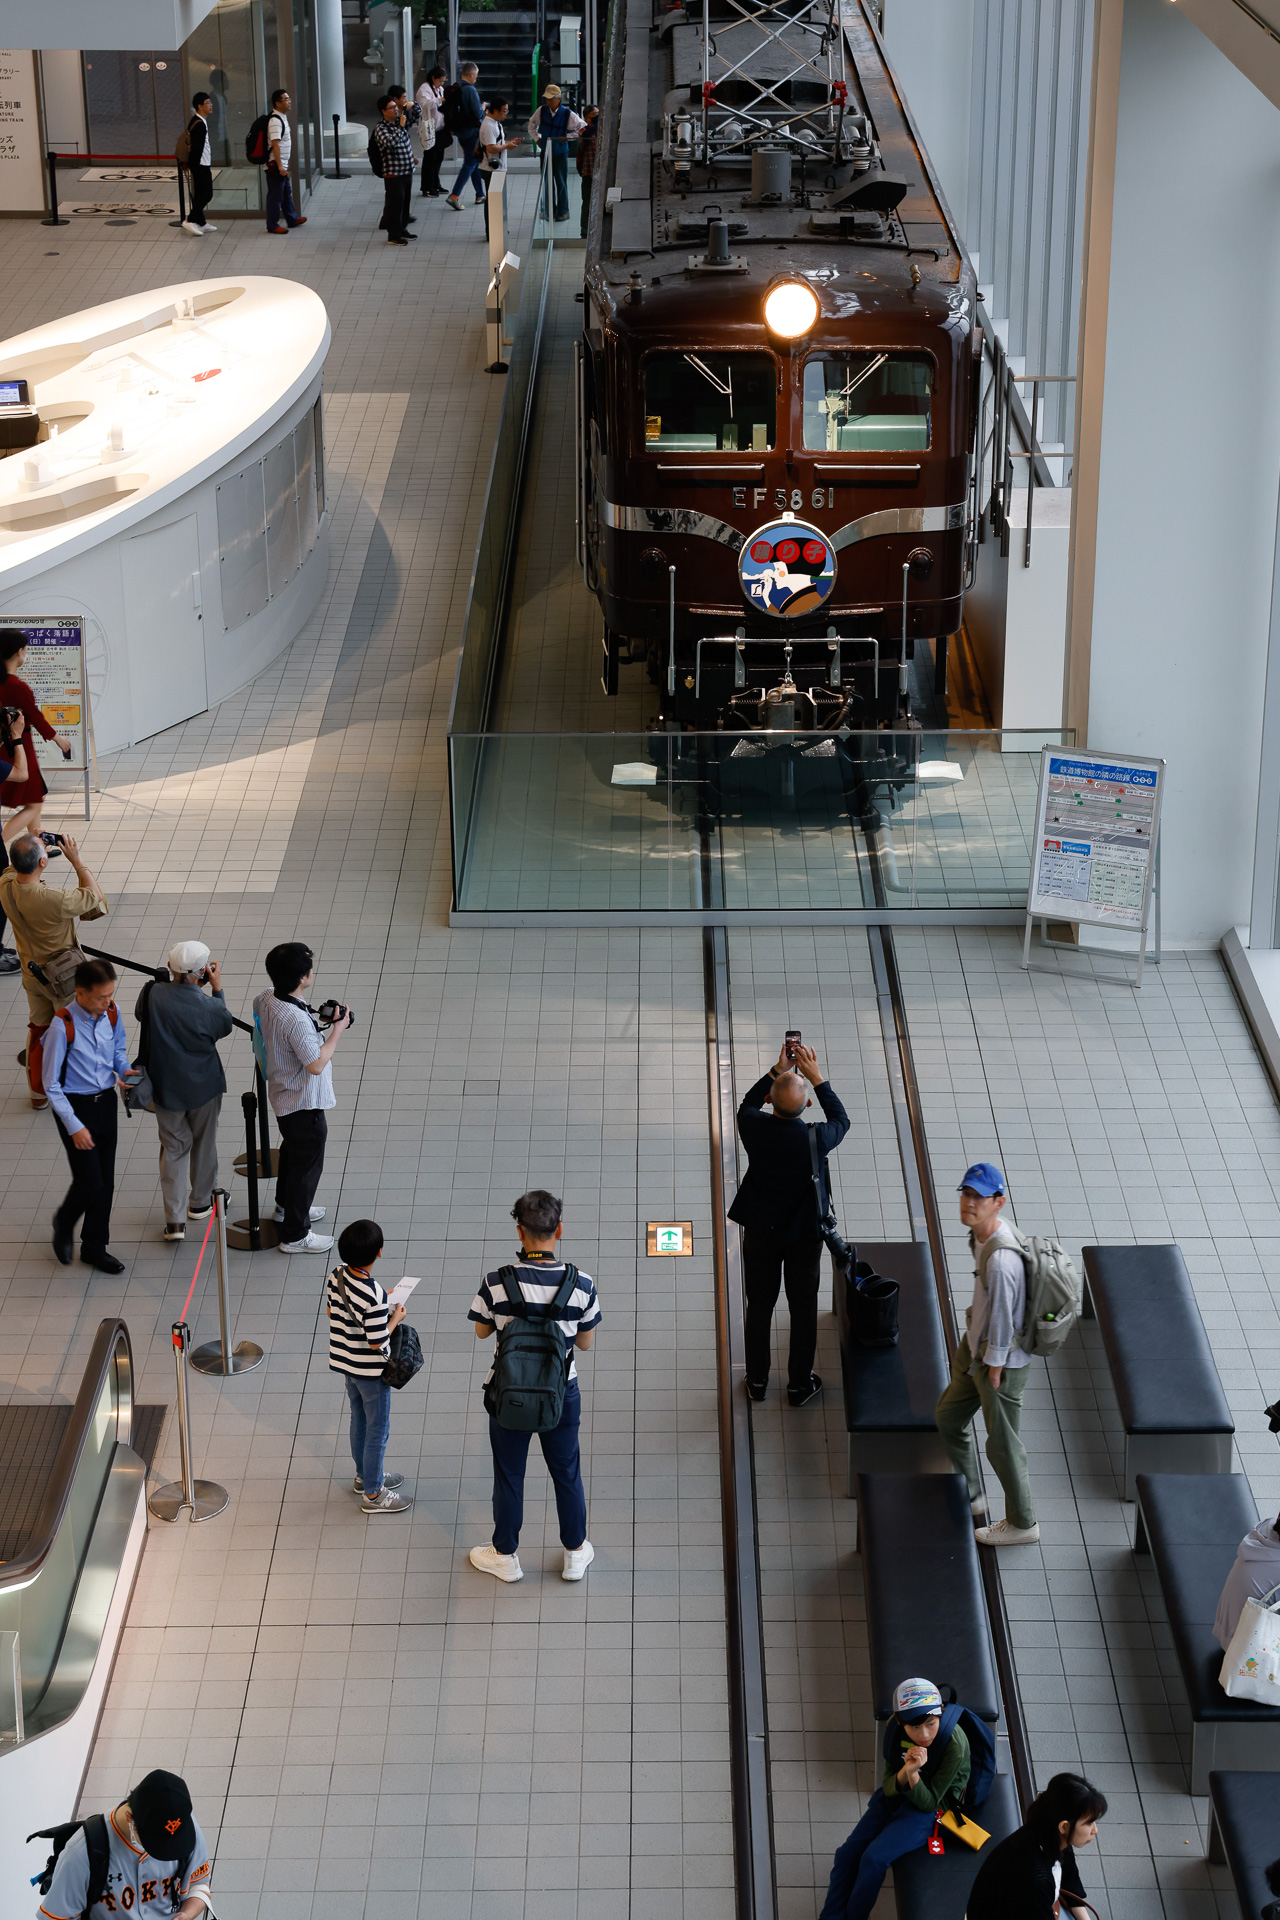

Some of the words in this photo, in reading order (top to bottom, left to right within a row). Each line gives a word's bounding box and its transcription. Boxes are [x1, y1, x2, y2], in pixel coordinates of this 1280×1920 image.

[753, 543, 823, 561] 踊り子
[1059, 765, 1131, 783] 鉄道博物館の隣の路線
